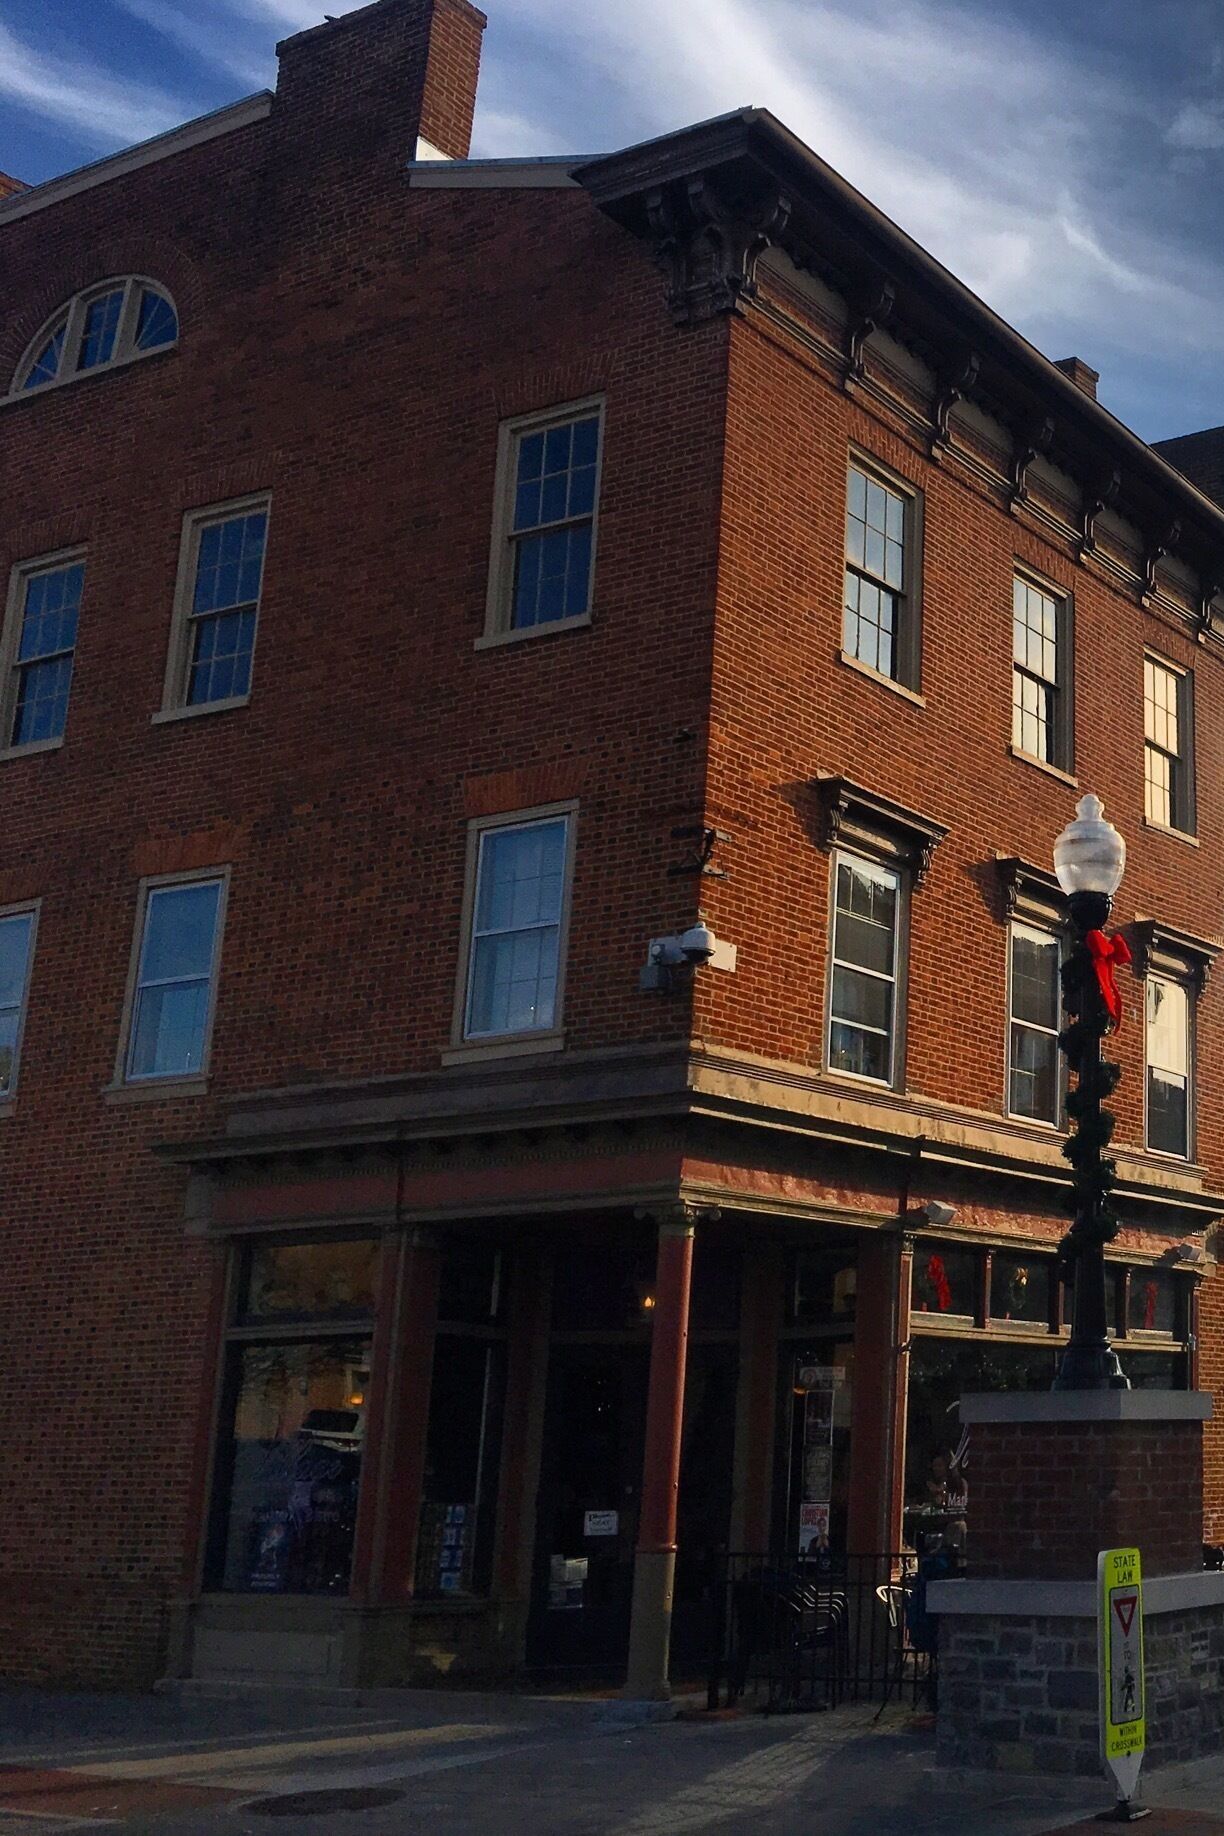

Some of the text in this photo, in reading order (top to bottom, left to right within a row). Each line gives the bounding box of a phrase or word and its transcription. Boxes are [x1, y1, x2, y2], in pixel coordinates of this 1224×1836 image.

[1113, 1554, 1136, 1568] STATE
[1117, 1570, 1133, 1584] LAW
[1119, 1724, 1137, 1736] WITHIN
[1111, 1735, 1142, 1752] CROSSWALK
